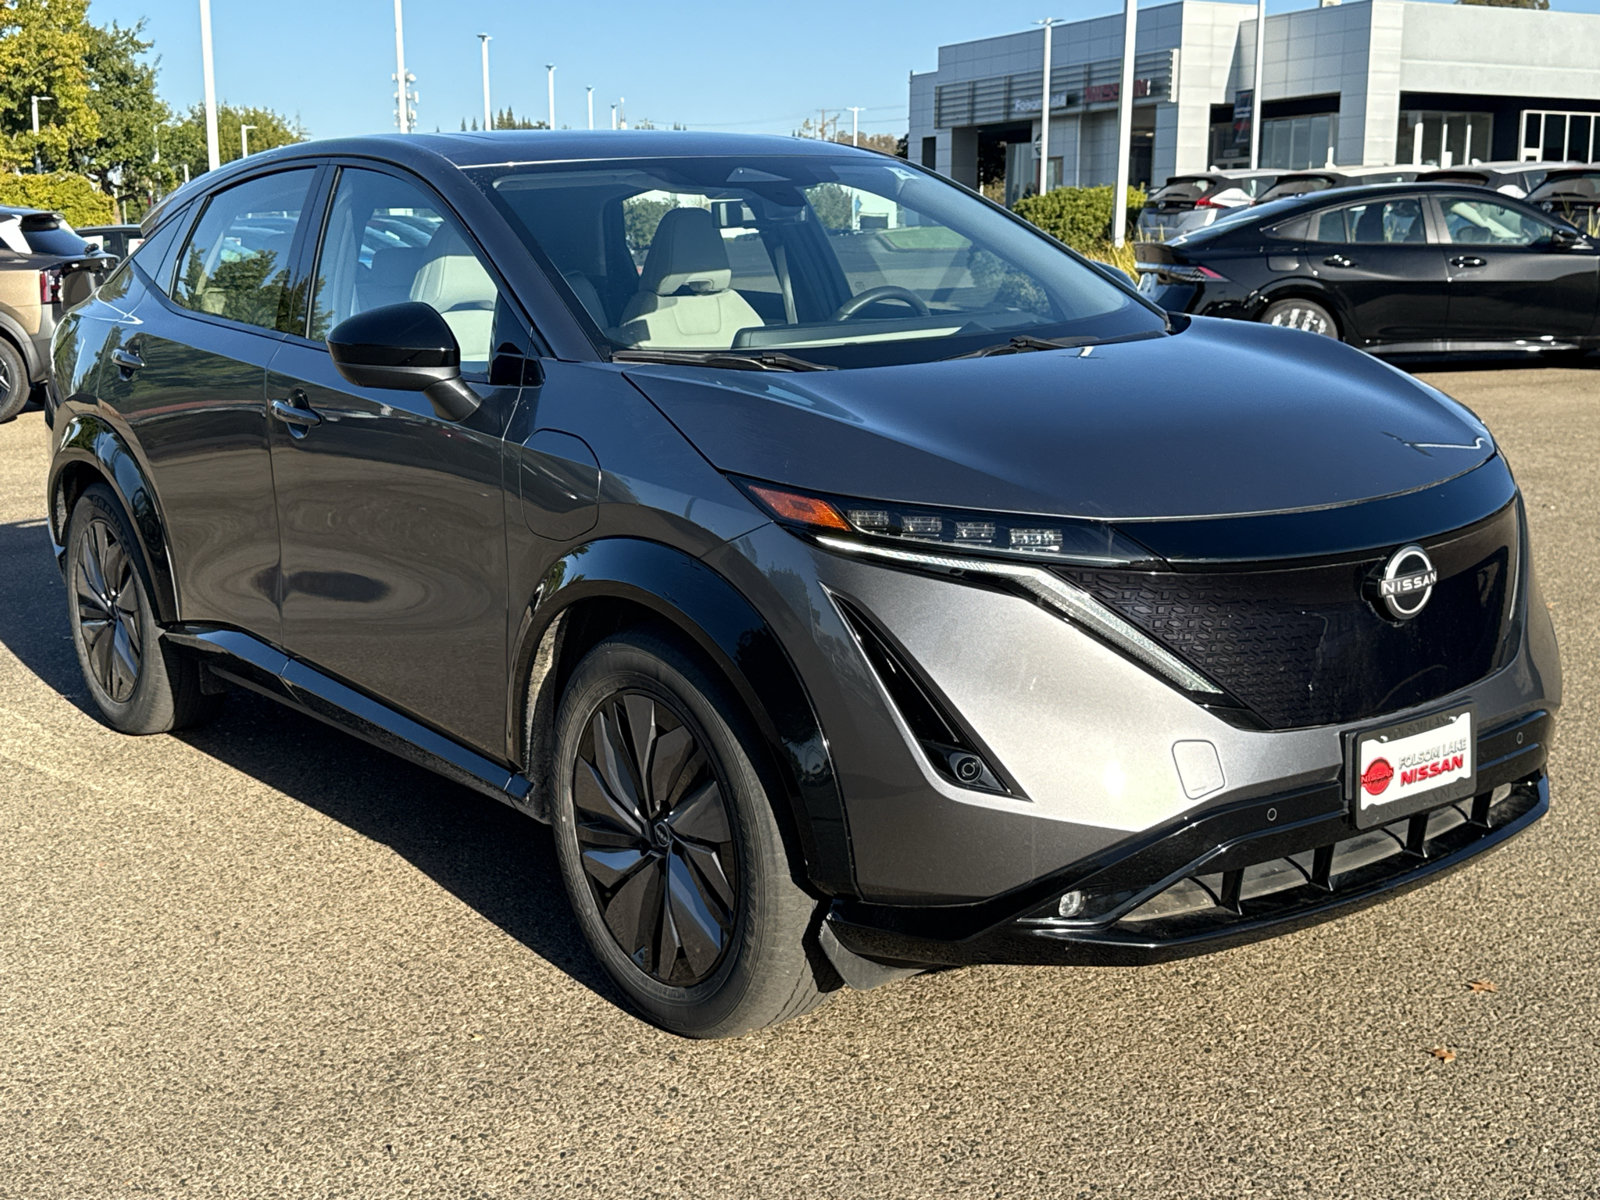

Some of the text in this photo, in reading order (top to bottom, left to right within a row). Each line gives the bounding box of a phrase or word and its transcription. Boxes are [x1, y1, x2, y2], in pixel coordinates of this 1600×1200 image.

[1383, 570, 1437, 594] NISSAN
[1399, 739, 1467, 769] FOLSOM LAKE
[1400, 754, 1464, 787] NISSAN
